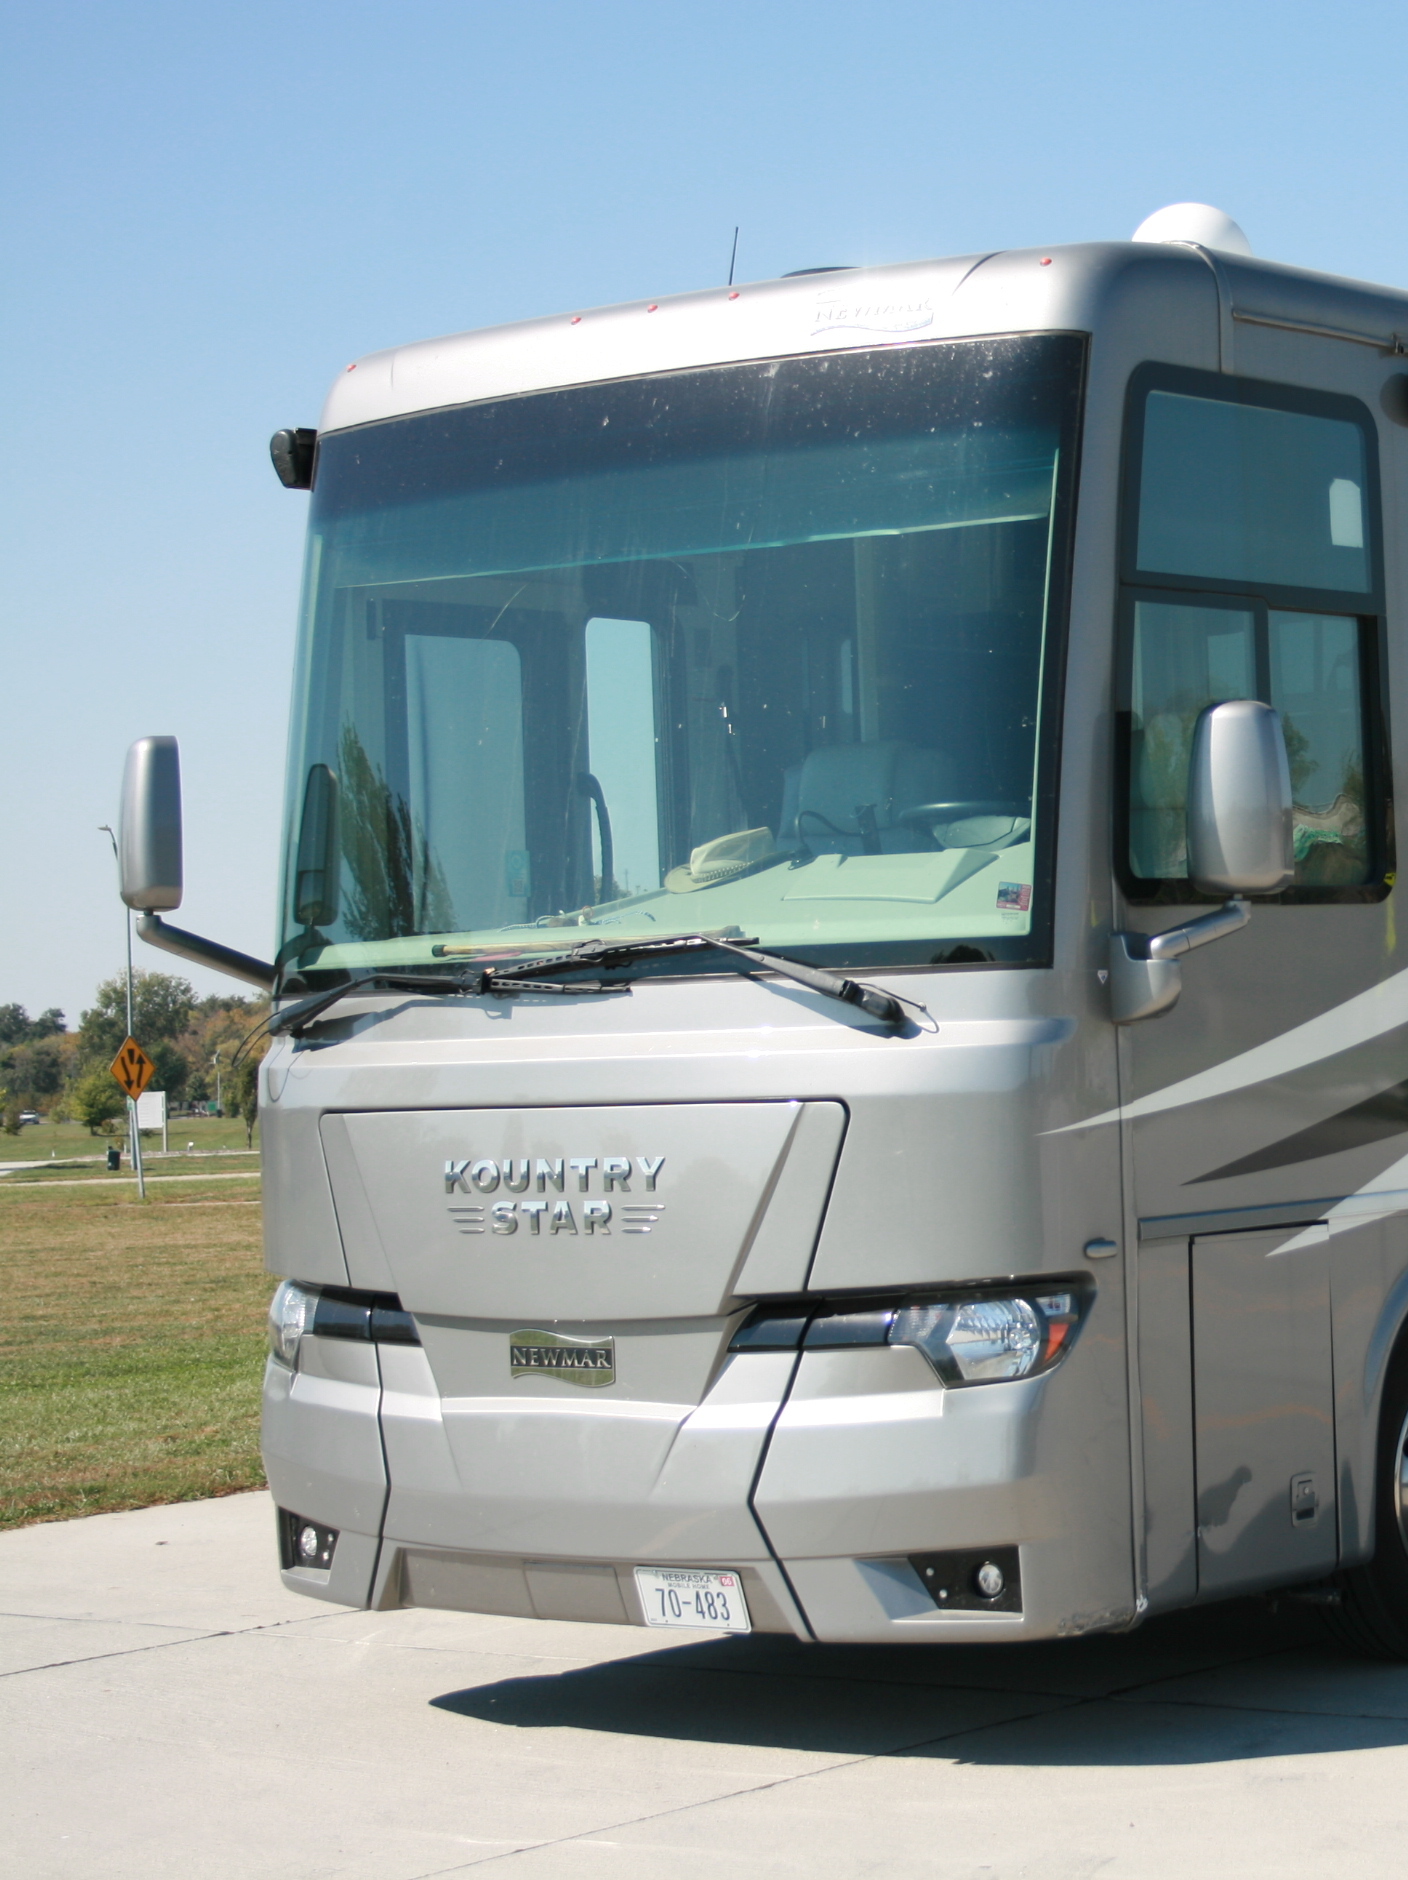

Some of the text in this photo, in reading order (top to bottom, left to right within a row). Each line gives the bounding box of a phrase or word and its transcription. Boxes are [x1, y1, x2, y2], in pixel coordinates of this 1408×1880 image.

[444, 1156, 666, 1194] KOUNTRY
[491, 1200, 612, 1235] STAR
[512, 1347, 612, 1368] NEWMAR
[661, 1572, 713, 1584] NEBRASKA
[655, 1588, 731, 1621] 70-483
